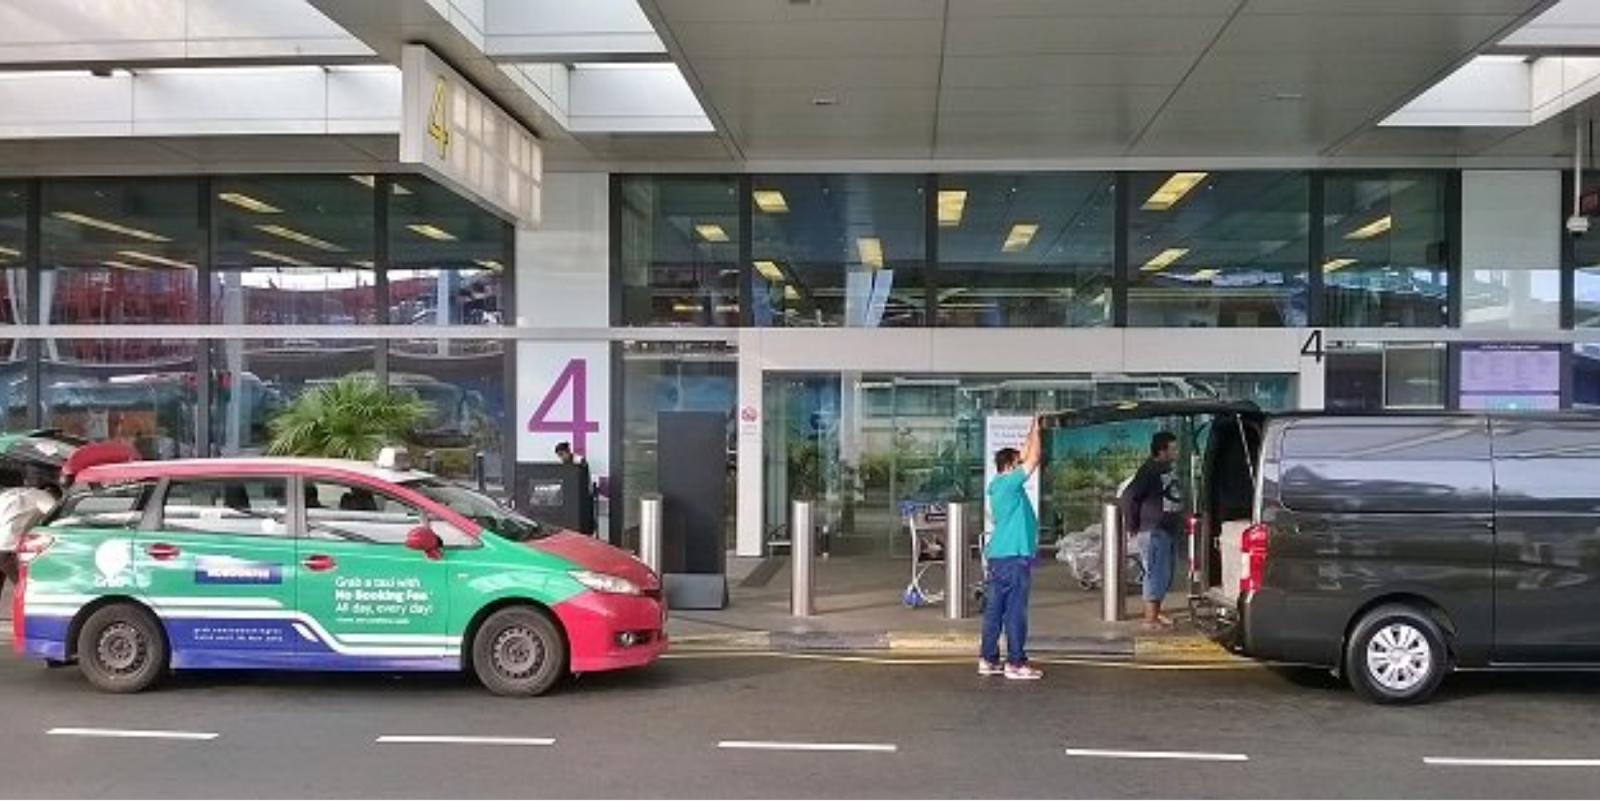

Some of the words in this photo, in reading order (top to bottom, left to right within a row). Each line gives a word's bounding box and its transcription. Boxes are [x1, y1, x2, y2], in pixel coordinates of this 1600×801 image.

[427, 74, 449, 160] 4
[1301, 329, 1325, 362] 4
[528, 358, 599, 457] 4
[335, 576, 362, 588] Grab
[373, 577, 396, 588] taxi
[396, 577, 421, 588] with
[335, 589, 354, 601] No
[355, 589, 404, 603] Booking
[335, 602, 349, 613] All
[352, 602, 375, 616] day,
[376, 604, 406, 616] every
